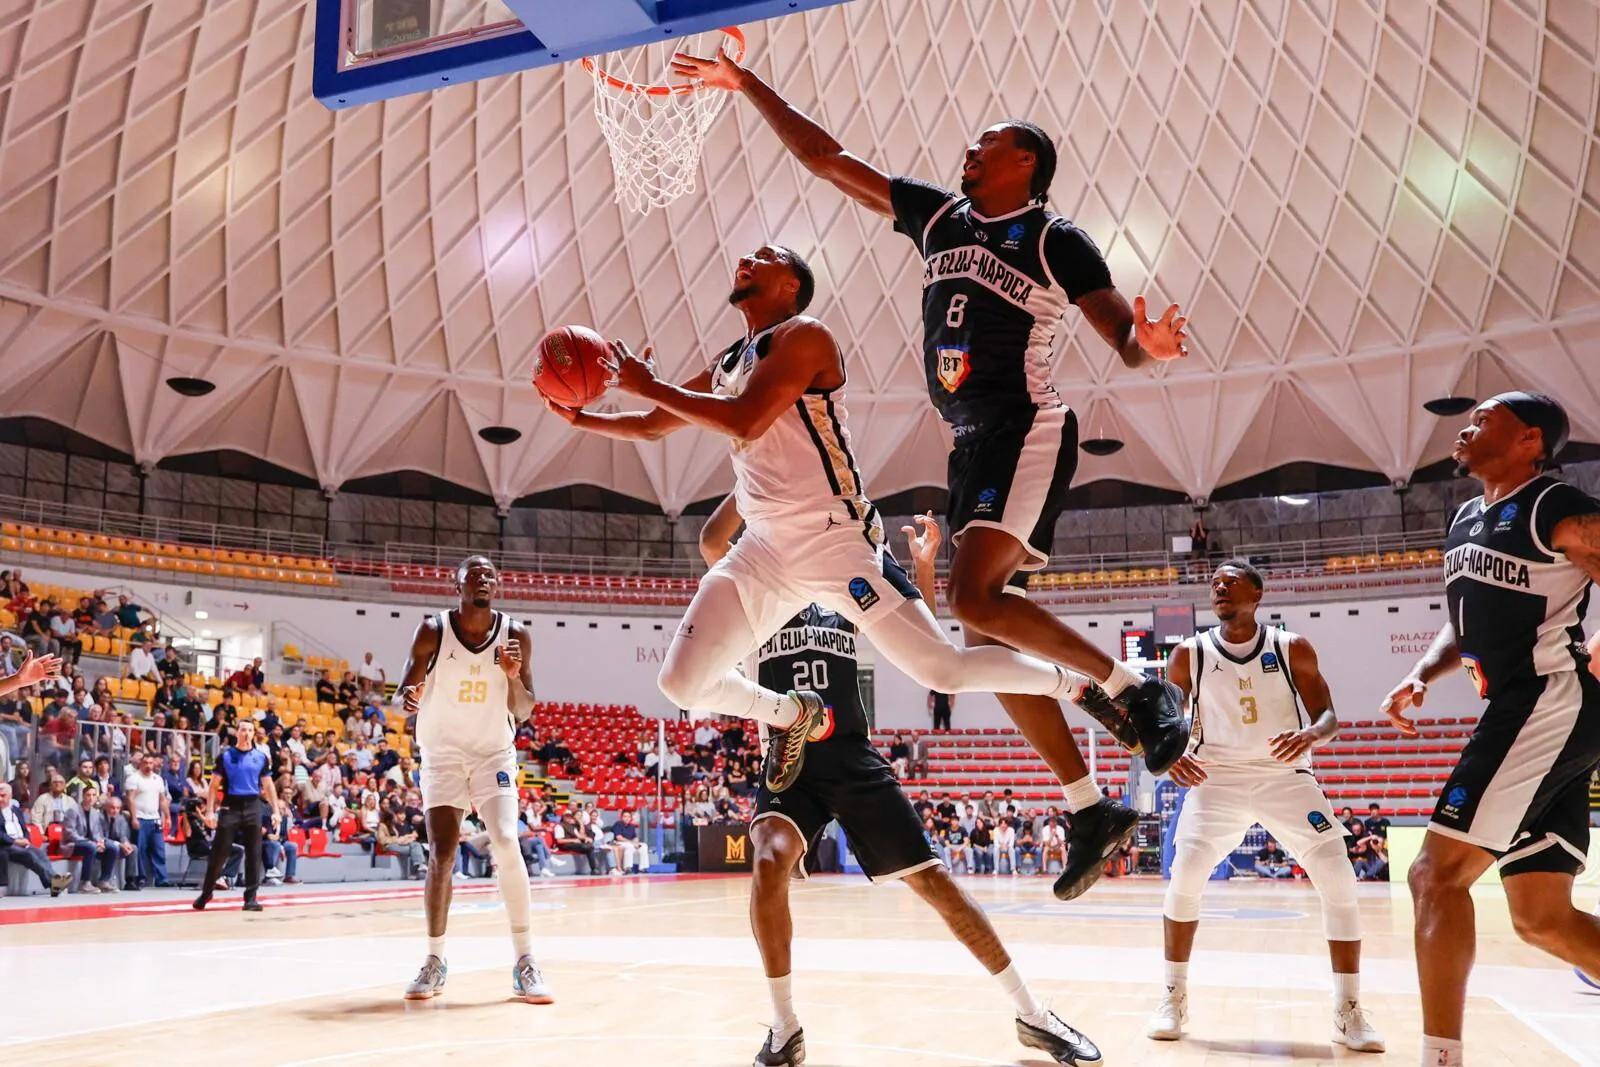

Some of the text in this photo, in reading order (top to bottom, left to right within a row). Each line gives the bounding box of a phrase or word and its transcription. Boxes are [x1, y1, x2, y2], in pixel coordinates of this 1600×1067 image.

[938, 249, 1033, 306] CLUJ-NAPOCA
[946, 293, 968, 328] 8
[942, 356, 962, 372] BT
[1446, 547, 1530, 589] CLUJ-NAPOCA
[780, 627, 857, 657] CLUJ-NAPOCA
[792, 659, 829, 691] 20
[458, 680, 488, 703] 29
[1240, 696, 1258, 724] 3
